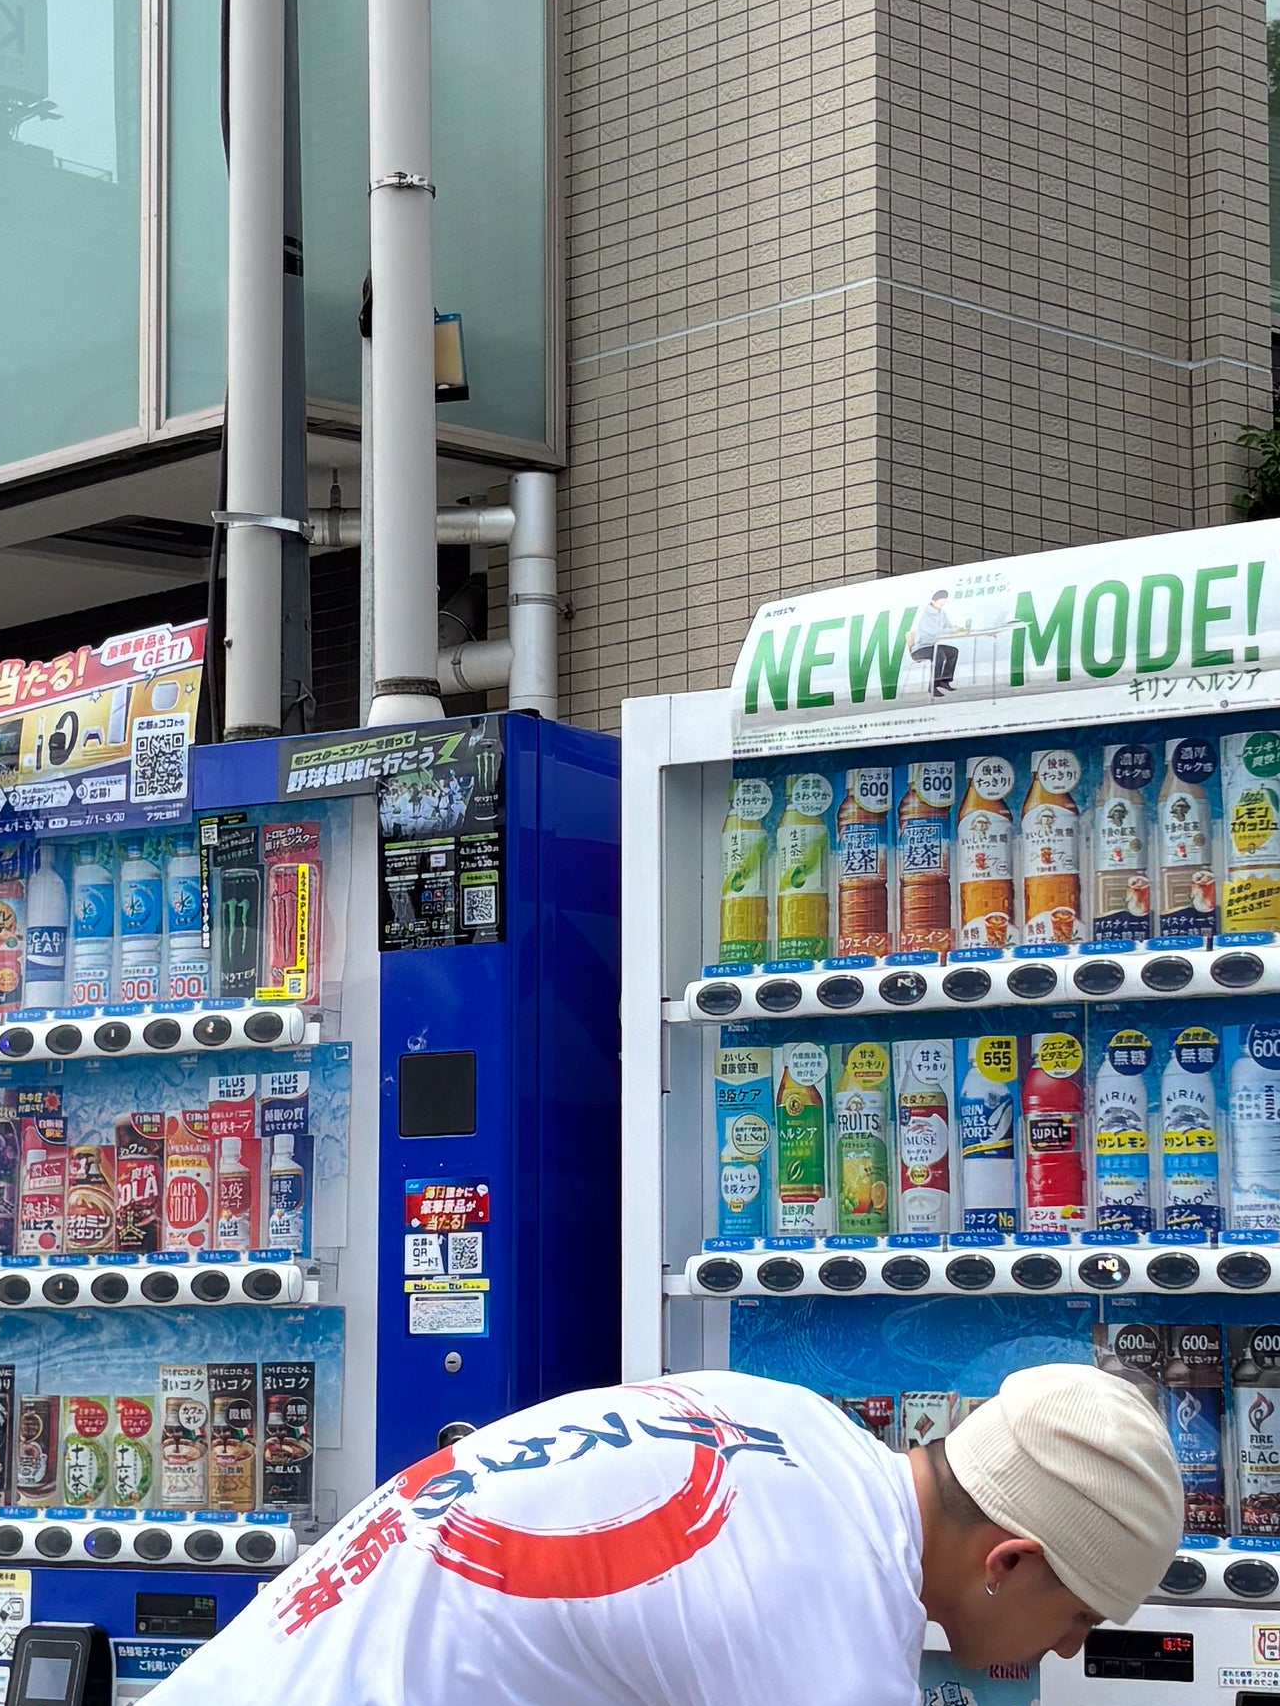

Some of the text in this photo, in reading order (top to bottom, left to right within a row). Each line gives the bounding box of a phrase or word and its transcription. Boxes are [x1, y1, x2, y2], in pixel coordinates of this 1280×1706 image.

[745, 560, 1266, 716] NEW MODE!
[142, 641, 184, 669] GET!
[1128, 668, 1263, 703] キリン ヘルシア
[1120, 752, 1147, 766] 濃厚
[1181, 746, 1207, 759] 濃厚
[860, 782, 889, 797] 600
[923, 776, 953, 791] 600
[735, 796, 769, 806] さわやか
[792, 791, 831, 802] さわやか
[1235, 806, 1270, 820] レモン
[1231, 818, 1280, 833] スカッシュ
[790, 829, 802, 856] 生茶
[905, 844, 940, 868] 麦茶
[724, 1053, 752, 1062] おいしく
[858, 1050, 875, 1060] 甘さ
[920, 1051, 942, 1062] 甘さ
[983, 1052, 1011, 1066] 555
[1041, 1050, 1080, 1061] ビタミンC
[1114, 1051, 1146, 1066] 無糖
[1181, 1048, 1214, 1063] 無糖
[219, 1077, 246, 1088] PLUS
[271, 1074, 298, 1085] PLUS
[1100, 1091, 1137, 1106] KIRIN
[1167, 1090, 1205, 1103] KIRIN
[1264, 1085, 1275, 1121] KIRIN
[838, 1112, 879, 1131] FRUITS
[779, 1127, 817, 1140] ヘルシア
[999, 1212, 1014, 1227] Na
[1250, 1434, 1273, 1444] FIRE
[987, 1663, 1030, 1681] KIRIN
